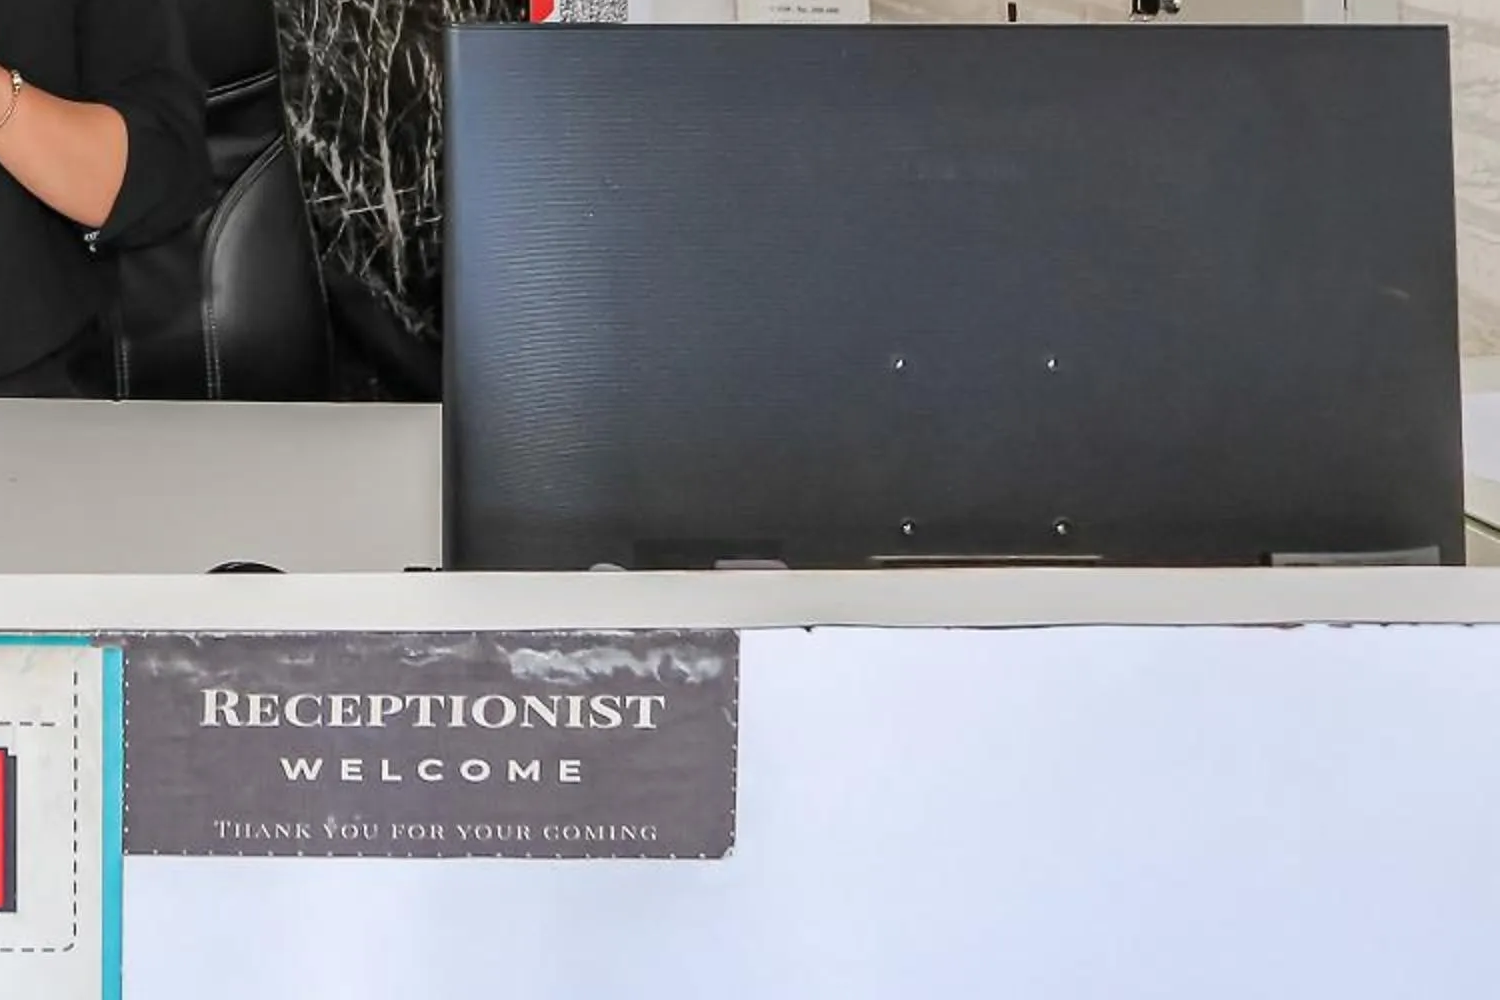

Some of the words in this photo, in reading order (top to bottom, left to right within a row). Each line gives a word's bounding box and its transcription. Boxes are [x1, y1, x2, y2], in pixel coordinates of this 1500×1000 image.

[200, 688, 665, 728] RECEPTIONIST
[280, 757, 582, 783] WELCOME
[213, 819, 312, 840] THANK
[322, 819, 380, 841] YOU
[391, 822, 446, 841] FOR
[456, 822, 532, 841] YOUR
[543, 822, 658, 841] COMING
